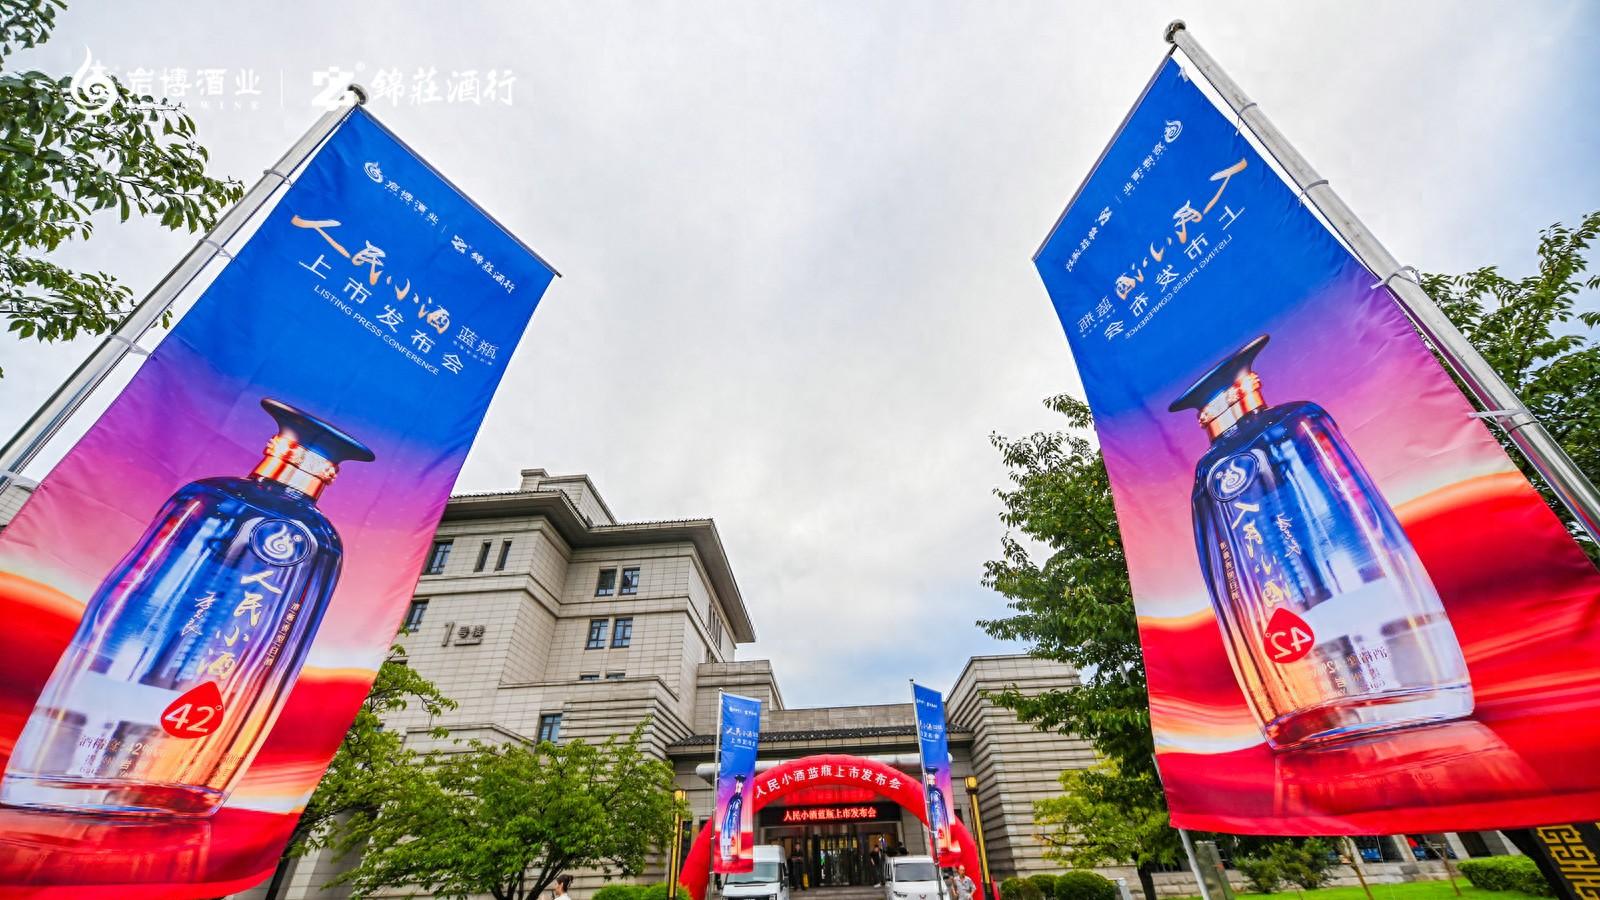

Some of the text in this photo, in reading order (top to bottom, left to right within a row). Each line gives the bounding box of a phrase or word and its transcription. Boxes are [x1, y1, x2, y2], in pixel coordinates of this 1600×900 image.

[290, 214, 451, 335] 人民小酒
[298, 254, 464, 375] 上市发布会
[313, 284, 353, 316] LISTING
[353, 312, 383, 337] PRESS
[383, 334, 440, 376] CONFERENCE
[754, 764, 902, 798] 人民小酒蓝瓶上市发布会
[784, 807, 876, 821] 人民小酒蓝瓶上市发布会
